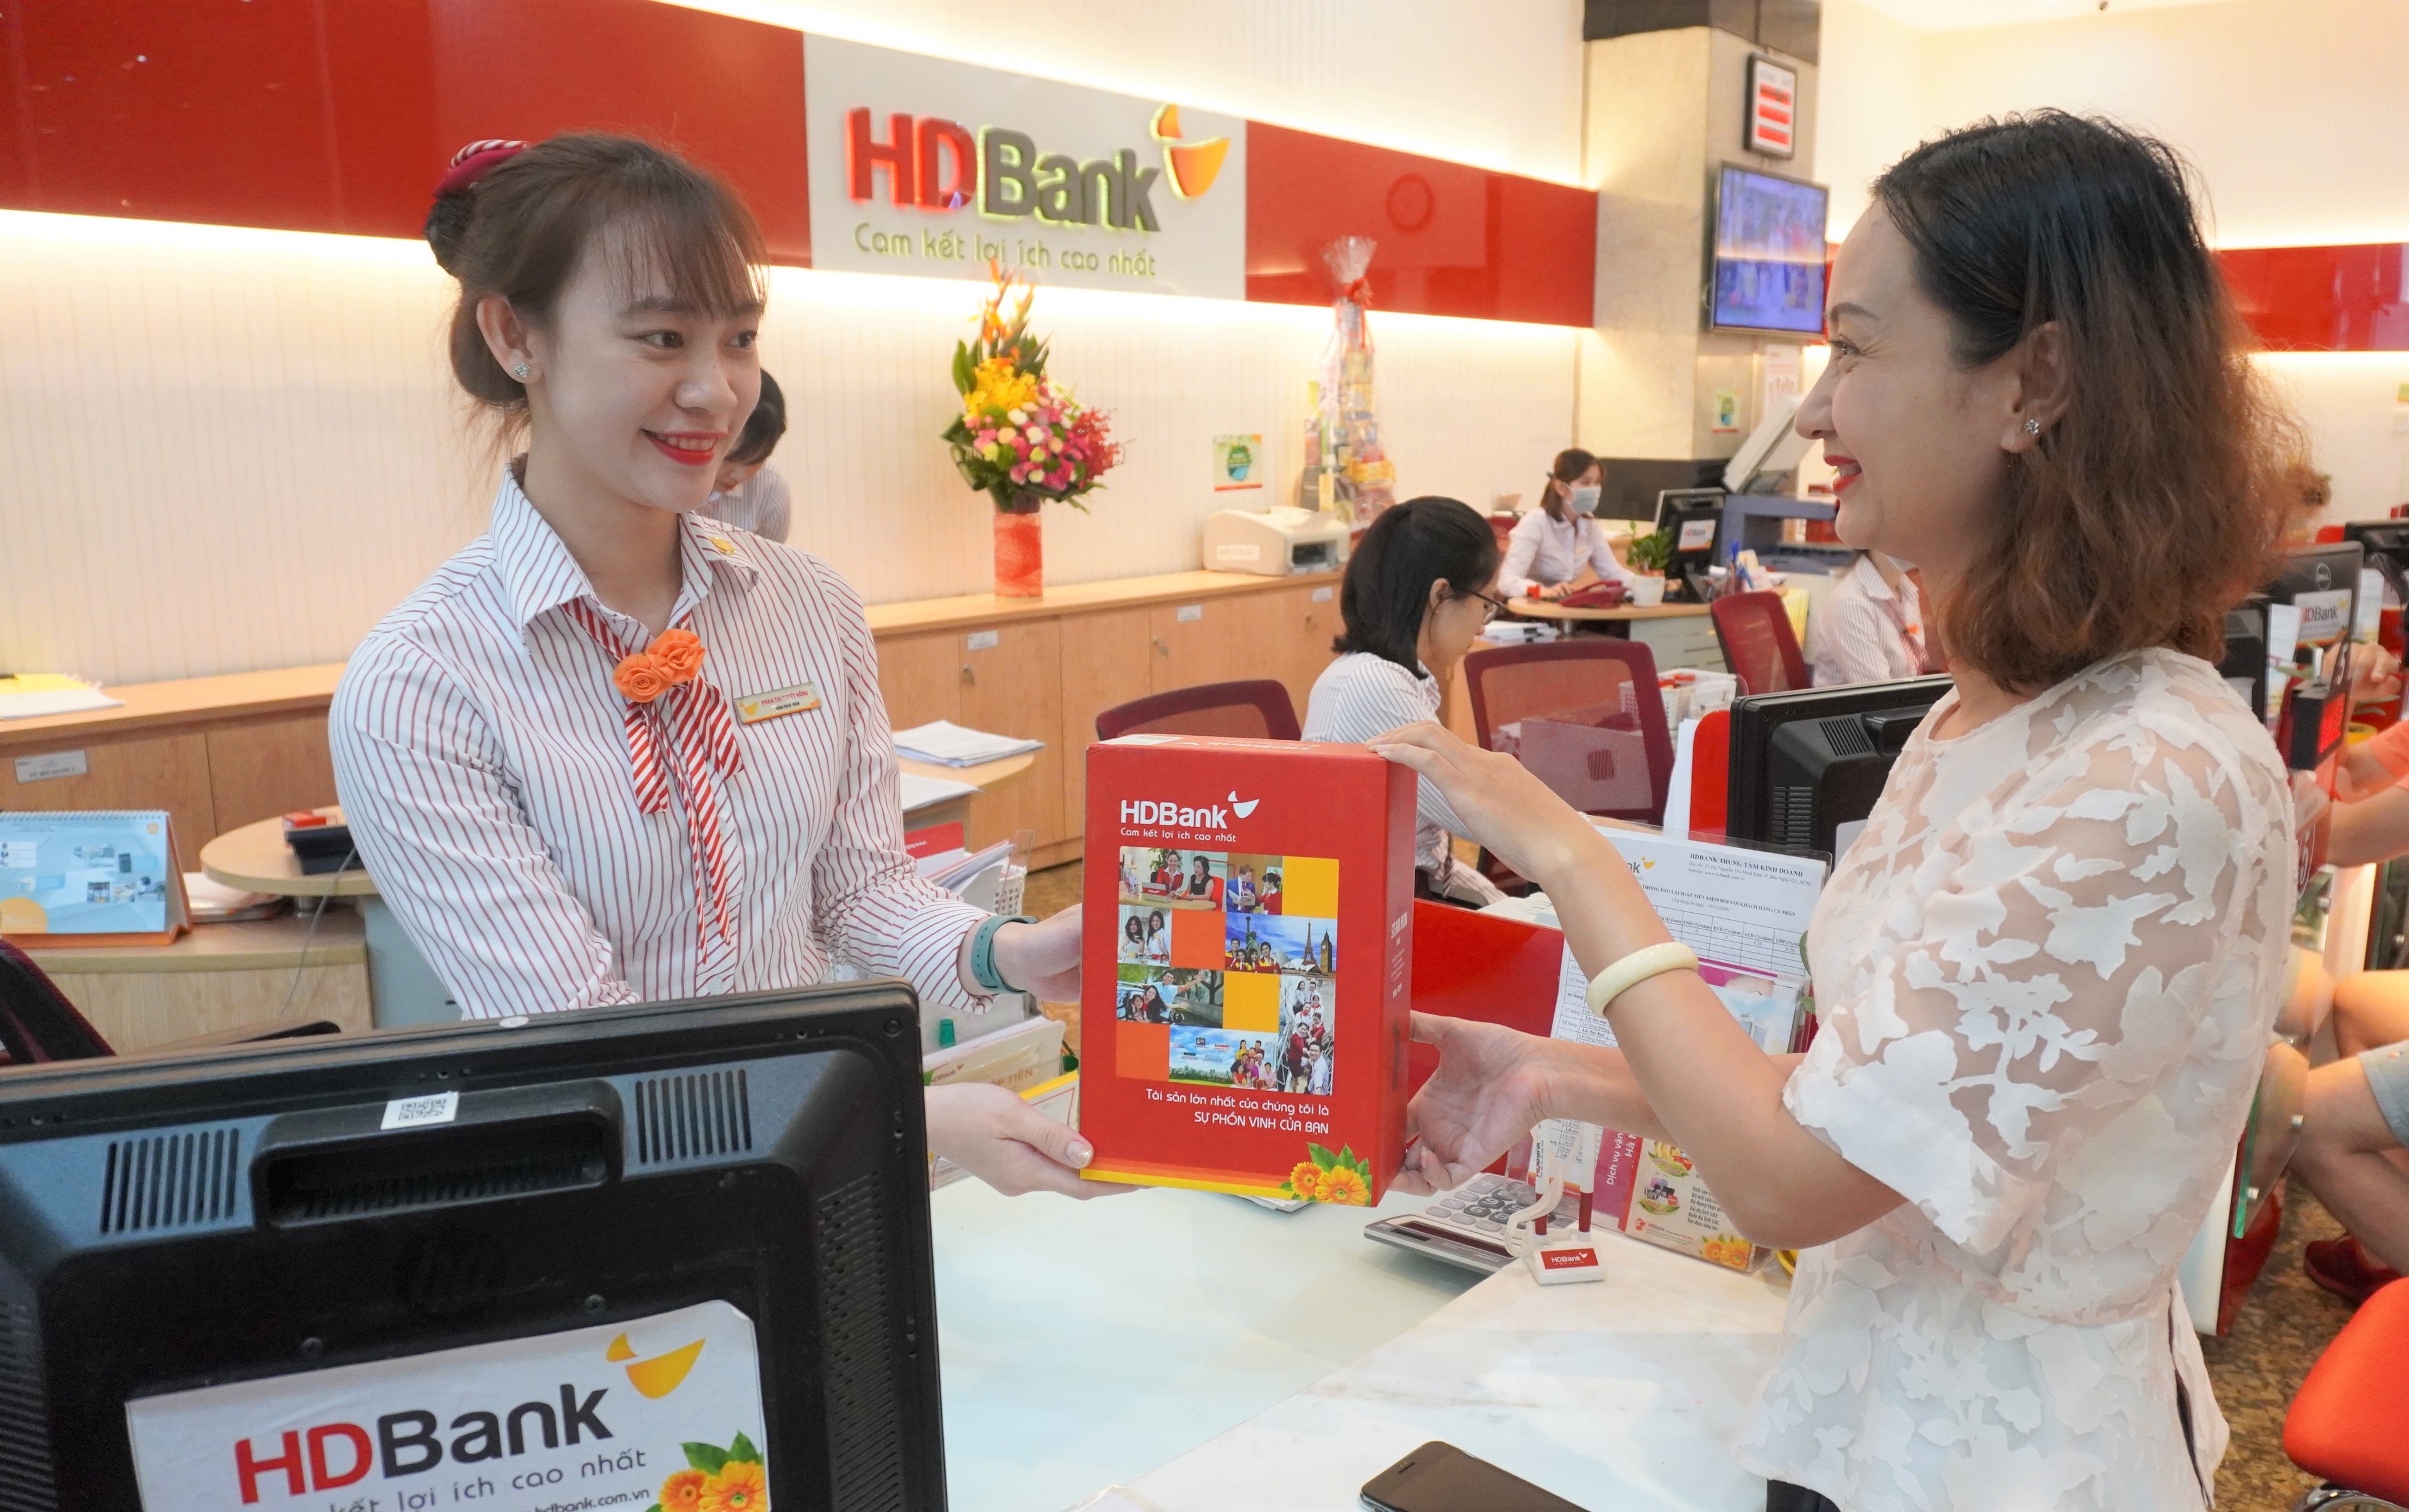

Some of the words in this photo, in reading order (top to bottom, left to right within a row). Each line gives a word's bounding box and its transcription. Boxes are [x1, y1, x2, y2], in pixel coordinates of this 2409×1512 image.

[845, 106, 1160, 231] HDBank
[854, 222, 912, 256] Cam
[922, 229, 964, 261] kết
[974, 234, 1005, 267] lợi
[1017, 239, 1050, 268] ích
[1058, 251, 1098, 272] cao
[1107, 248, 1155, 277] nhất
[1121, 799, 1228, 829] HDBank
[1121, 827, 1139, 837] Cam
[1143, 827, 1158, 839] kết
[1162, 828, 1174, 840] lợi
[1177, 829, 1191, 840] ích
[1194, 832, 1211, 841] cao
[1215, 831, 1237, 843] nhất
[1690, 853, 1719, 863] HDBANK
[1719, 857, 1742, 867] TRUNG
[1744, 861, 1759, 870] TÂM
[1760, 865, 1777, 873] KINH
[1779, 868, 1804, 877] DOANH
[1146, 1088, 1163, 1102] Tài
[1166, 1091, 1186, 1104] sản
[1189, 1092, 1207, 1106] lớn
[1210, 1093, 1236, 1108] nhất
[1239, 1096, 1259, 1110] của
[1262, 1097, 1295, 1115] chúng
[1298, 1101, 1314, 1115] tôi
[1317, 1101, 1329, 1116] là
[1194, 1111, 1210, 1126] SỰ
[1211, 1111, 1246, 1127] PHỒN
[1249, 1116, 1276, 1130] VINH
[1279, 1116, 1302, 1132] CỦA
[1305, 1121, 1329, 1135] BẠN
[1615, 1133, 1624, 1148] vận
[1624, 1142, 1635, 1158] Hà
[1612, 1152, 1622, 1163] vụ
[1606, 1164, 1618, 1186] Dịch
[1551, 1255, 1581, 1263] HDBank
[234, 1383, 614, 1504] HDBank
[398, 1487, 437, 1512] lợi
[453, 1477, 495, 1502] ích
[512, 1468, 563, 1490] cao
[580, 1447, 647, 1478] nhất
